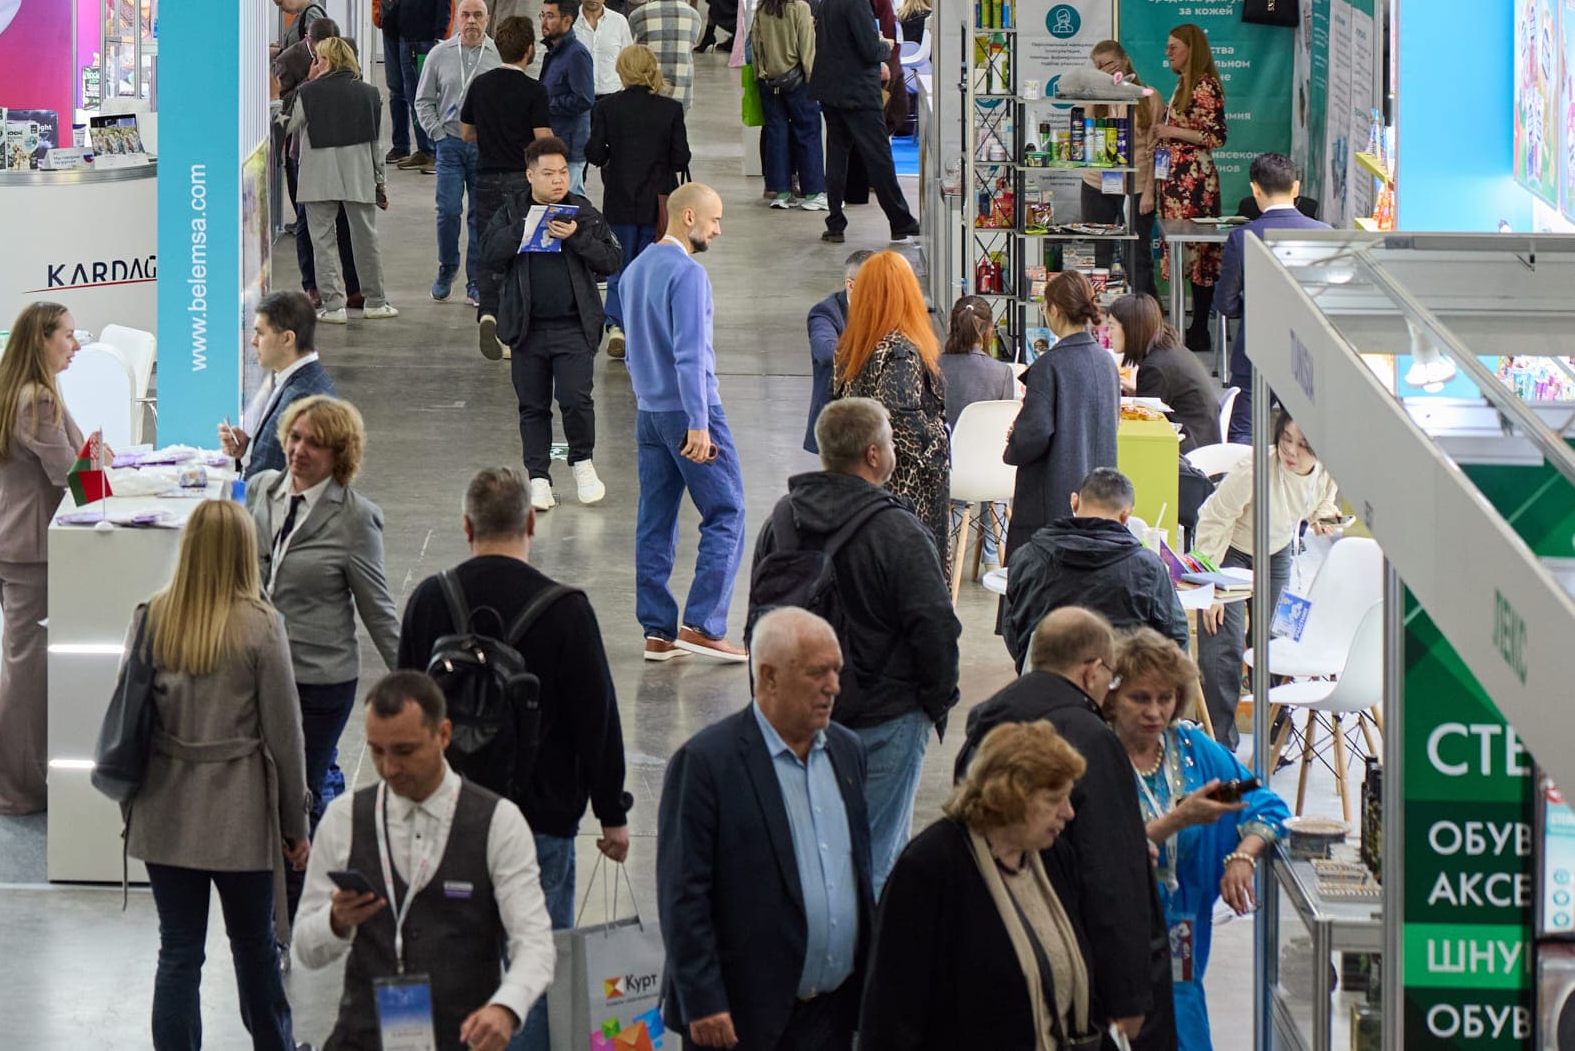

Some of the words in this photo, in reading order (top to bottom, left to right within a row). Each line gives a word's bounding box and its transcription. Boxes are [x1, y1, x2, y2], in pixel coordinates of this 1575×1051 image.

[1179, 7, 1191, 15] за
[1194, 4, 1233, 16] кожей
[1211, 47, 1234, 55] ства
[1214, 60, 1250, 68] льном
[1224, 111, 1251, 120] имия
[47, 255, 157, 288] KARDAG
[187, 164, 208, 372] www.belemsa.com
[1428, 820, 1532, 856] ОБУВ
[1427, 939, 1524, 975] ШНУ
[1427, 1003, 1531, 1040] ОБУВ
